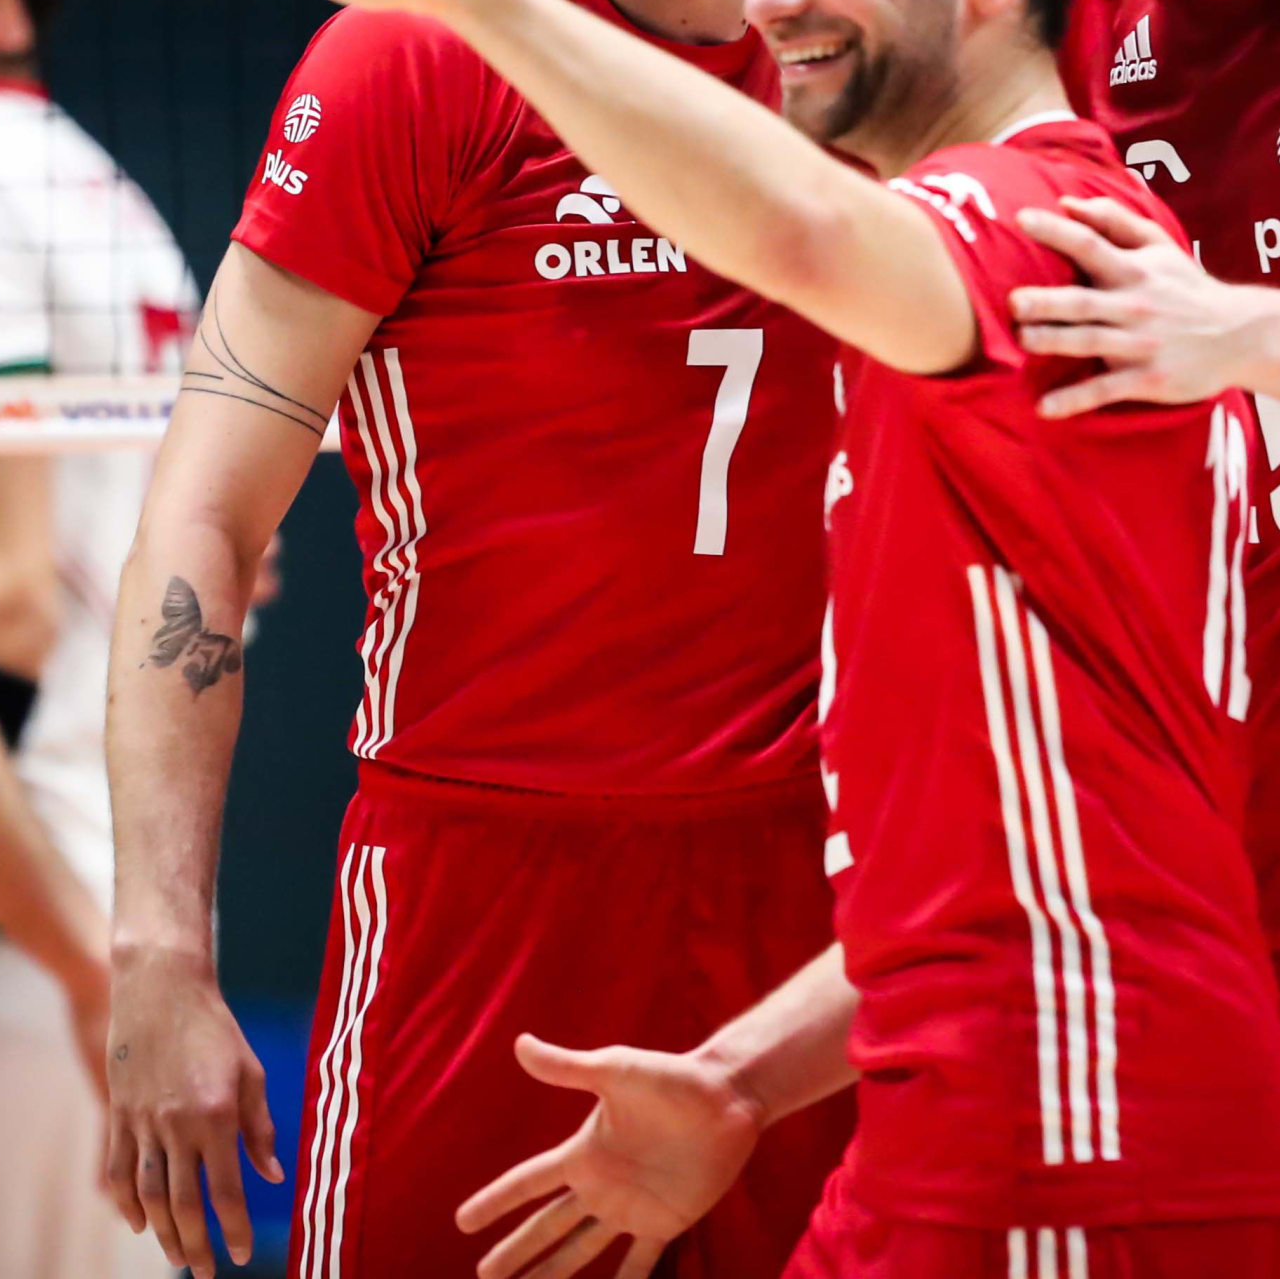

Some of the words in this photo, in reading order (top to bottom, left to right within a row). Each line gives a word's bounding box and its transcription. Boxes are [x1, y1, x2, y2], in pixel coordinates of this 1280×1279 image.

[1109, 58, 1158, 88] adidas
[261, 149, 309, 196] plus
[534, 237, 688, 281] ORLEN
[686, 328, 764, 556] 7
